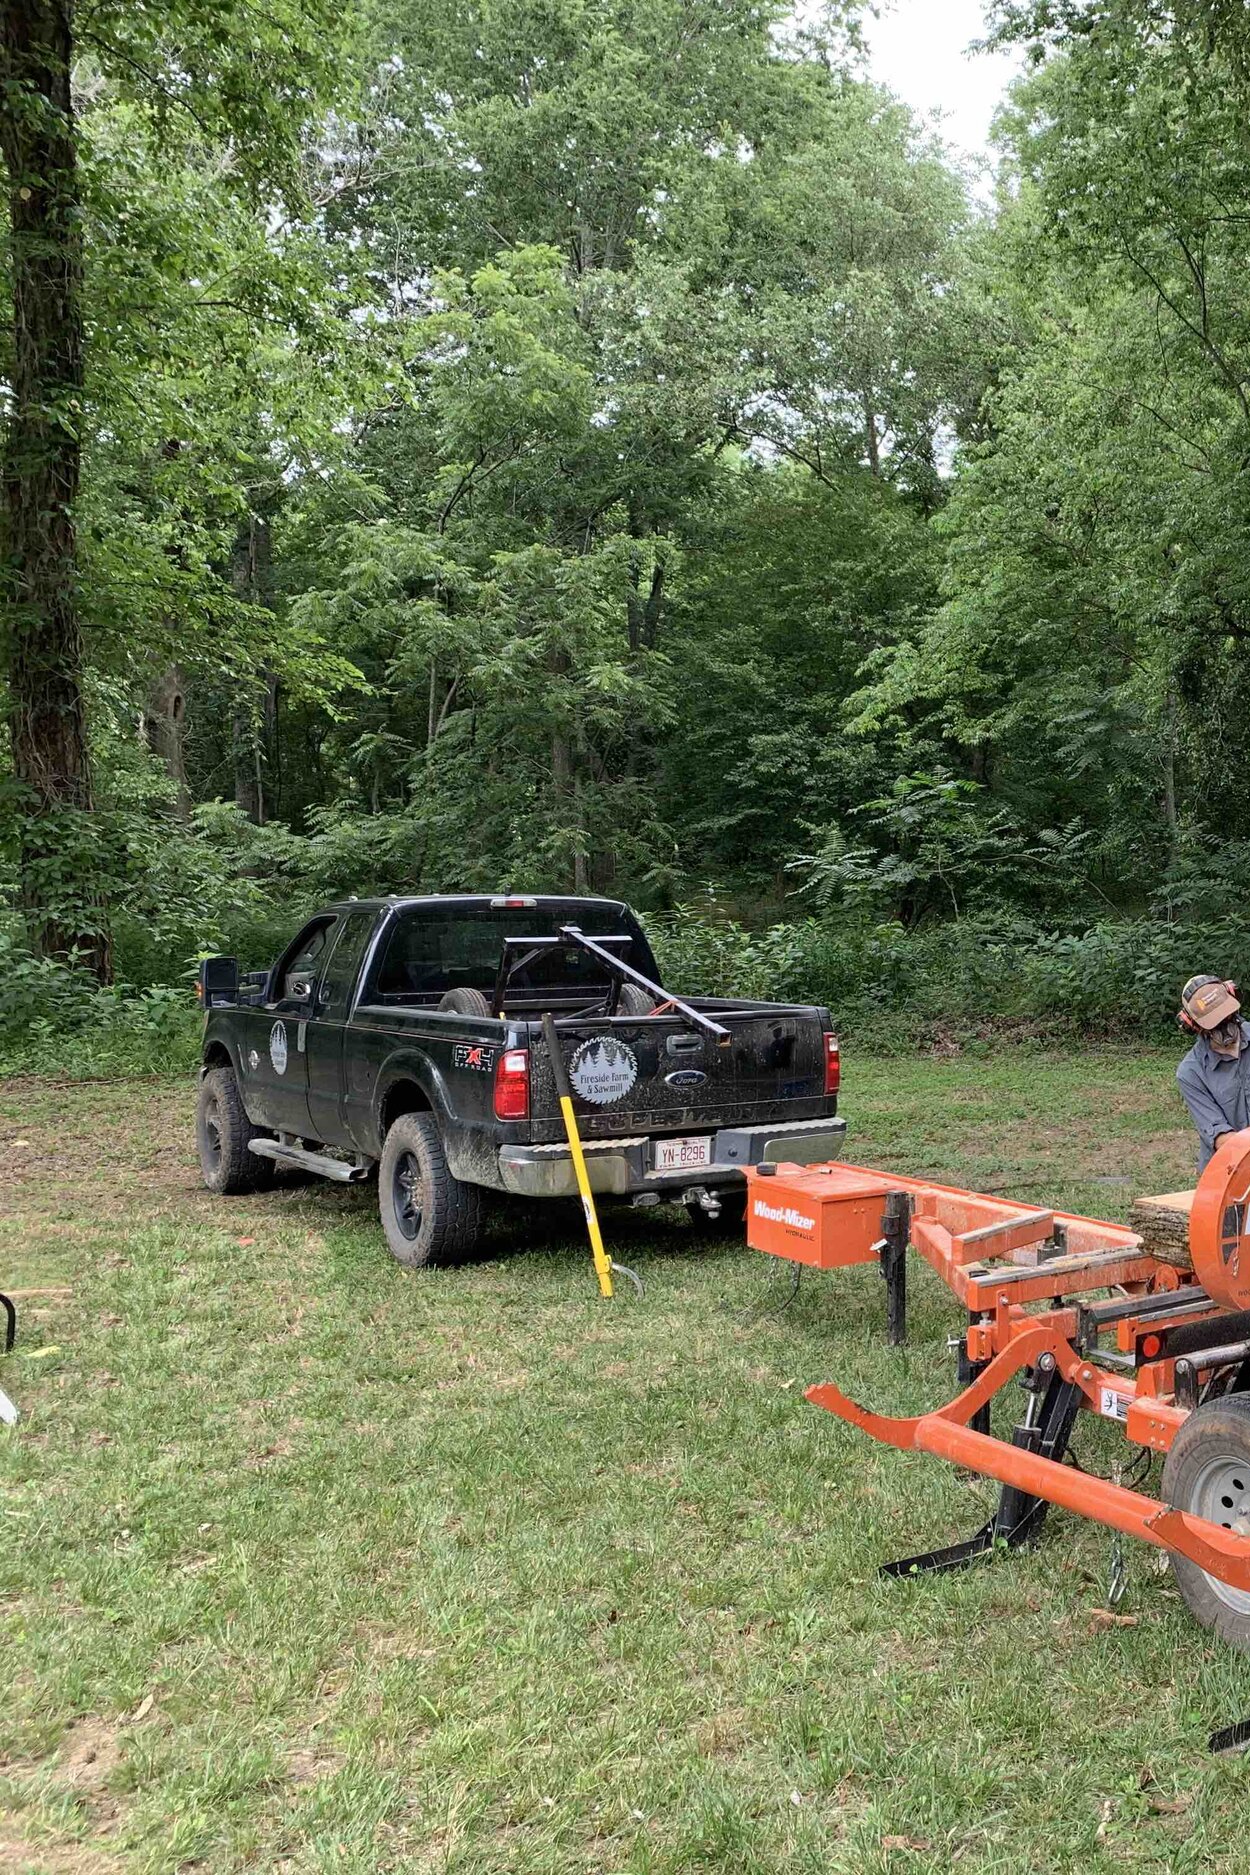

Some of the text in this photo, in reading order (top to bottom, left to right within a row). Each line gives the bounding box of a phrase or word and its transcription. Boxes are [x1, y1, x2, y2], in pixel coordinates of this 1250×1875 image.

[580, 1072, 629, 1084] Fireside Farm
[587, 1083, 623, 1094] & Sawmill
[662, 1145, 705, 1164] YN-8296
[753, 1200, 815, 1231] Wood-Mizer
